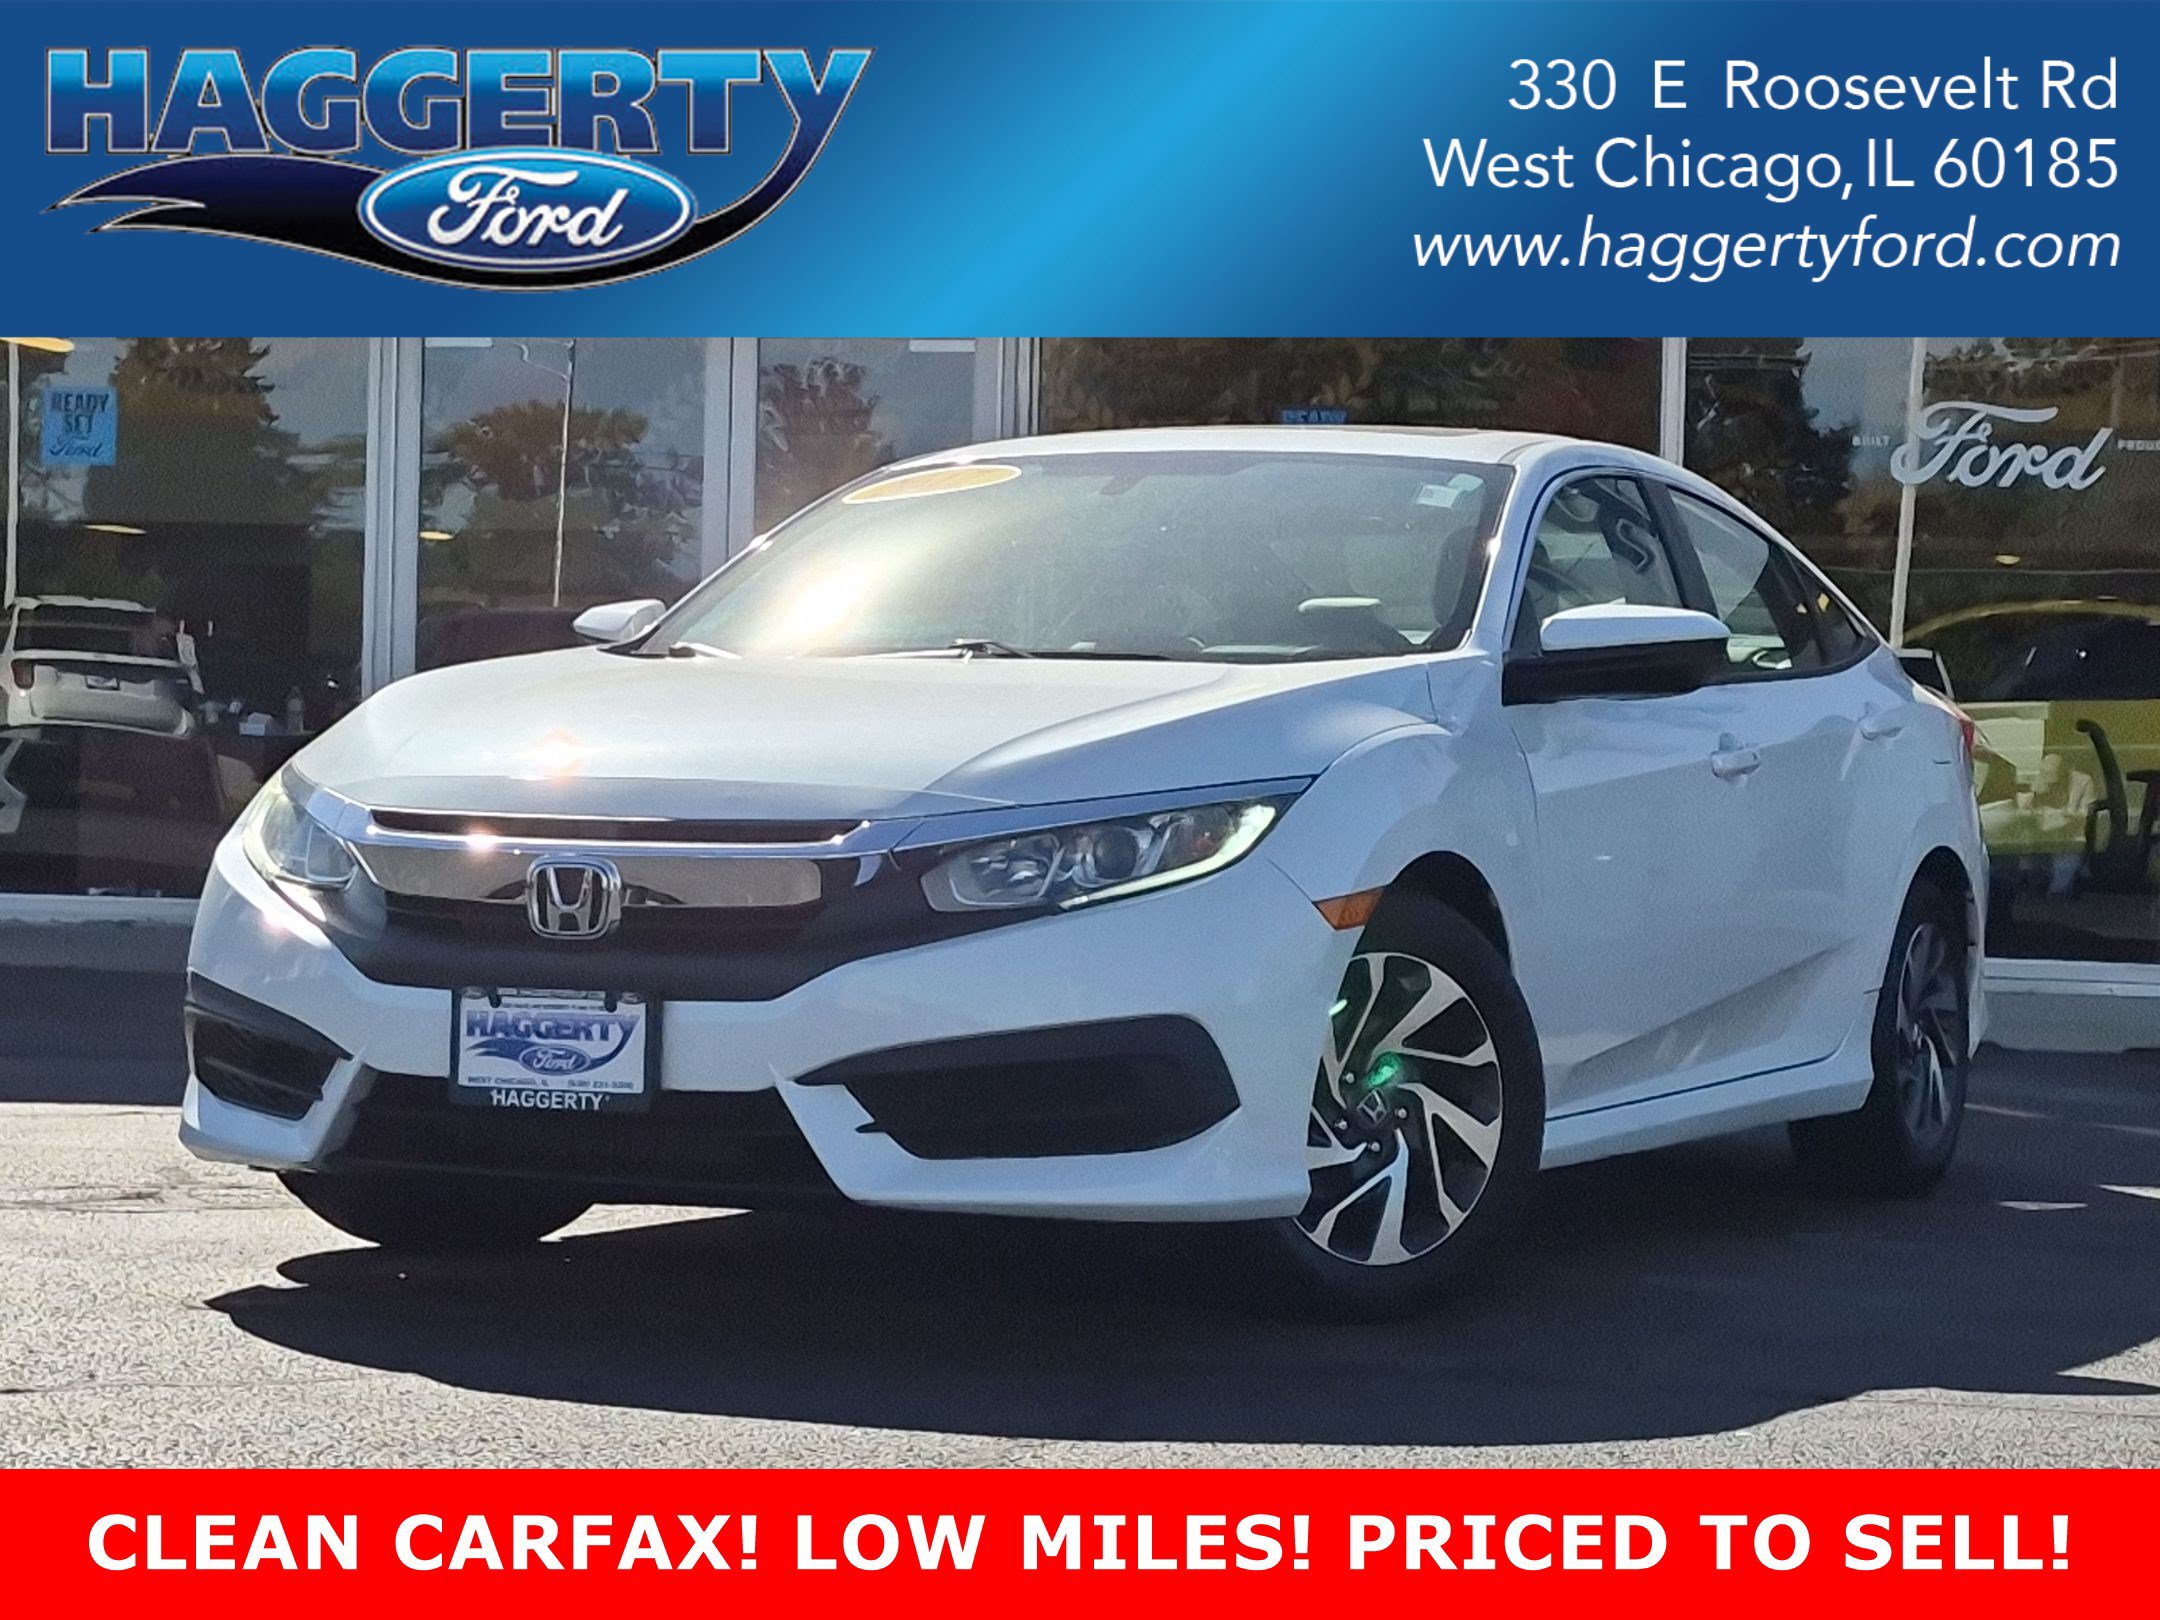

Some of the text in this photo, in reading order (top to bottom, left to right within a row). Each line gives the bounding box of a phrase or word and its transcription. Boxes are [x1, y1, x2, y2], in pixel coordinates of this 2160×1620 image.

[1890, 401, 2113, 490] Ford
[466, 1009, 641, 1042] HAGGERTY
[533, 1049, 577, 1070] Ford
[490, 1088, 603, 1111] HAGGERTY
